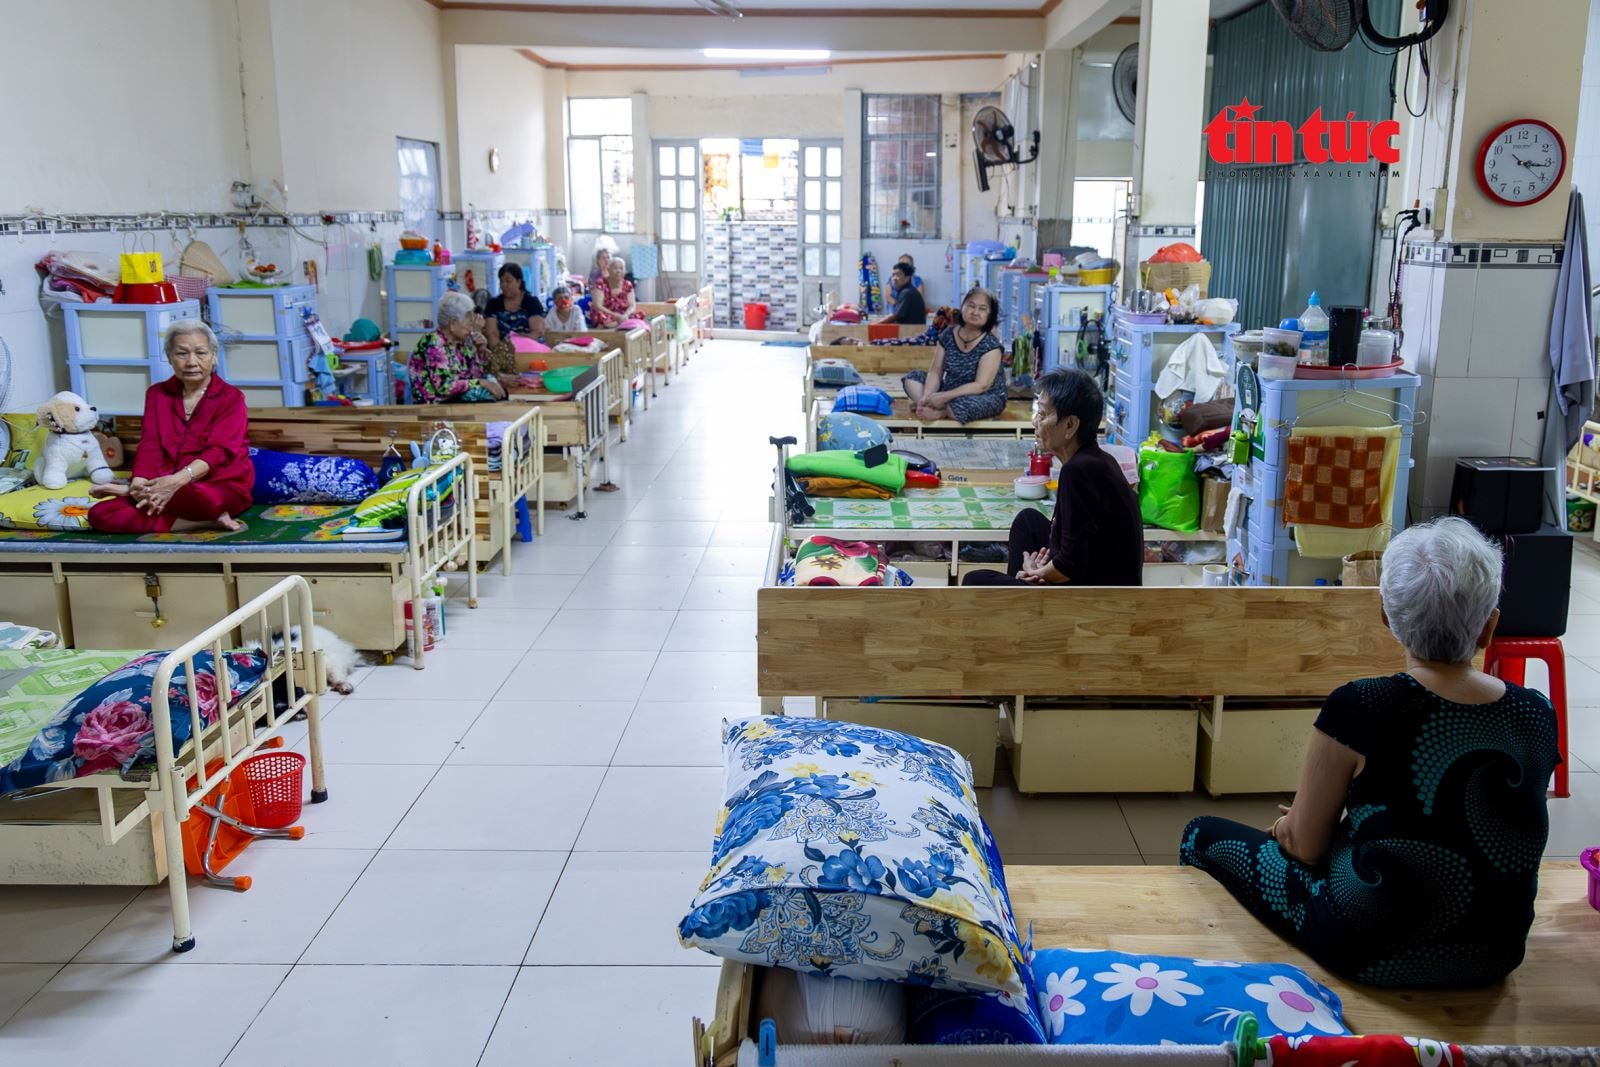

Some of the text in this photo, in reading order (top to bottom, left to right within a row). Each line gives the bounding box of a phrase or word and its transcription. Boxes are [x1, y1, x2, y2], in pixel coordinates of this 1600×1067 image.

[1504, 134, 1513, 144] 11
[1518, 130, 1529, 140] 12
[1494, 145, 1503, 155] 10
[1541, 143, 1549, 153] 2
[1488, 159, 1496, 169] 9
[1544, 157, 1552, 168] 3
[1490, 173, 1498, 182] 8
[1538, 172, 1545, 182] 4
[1500, 183, 1507, 192] 7
[1513, 186, 1520, 196] 6
[1528, 182, 1536, 191] 5
